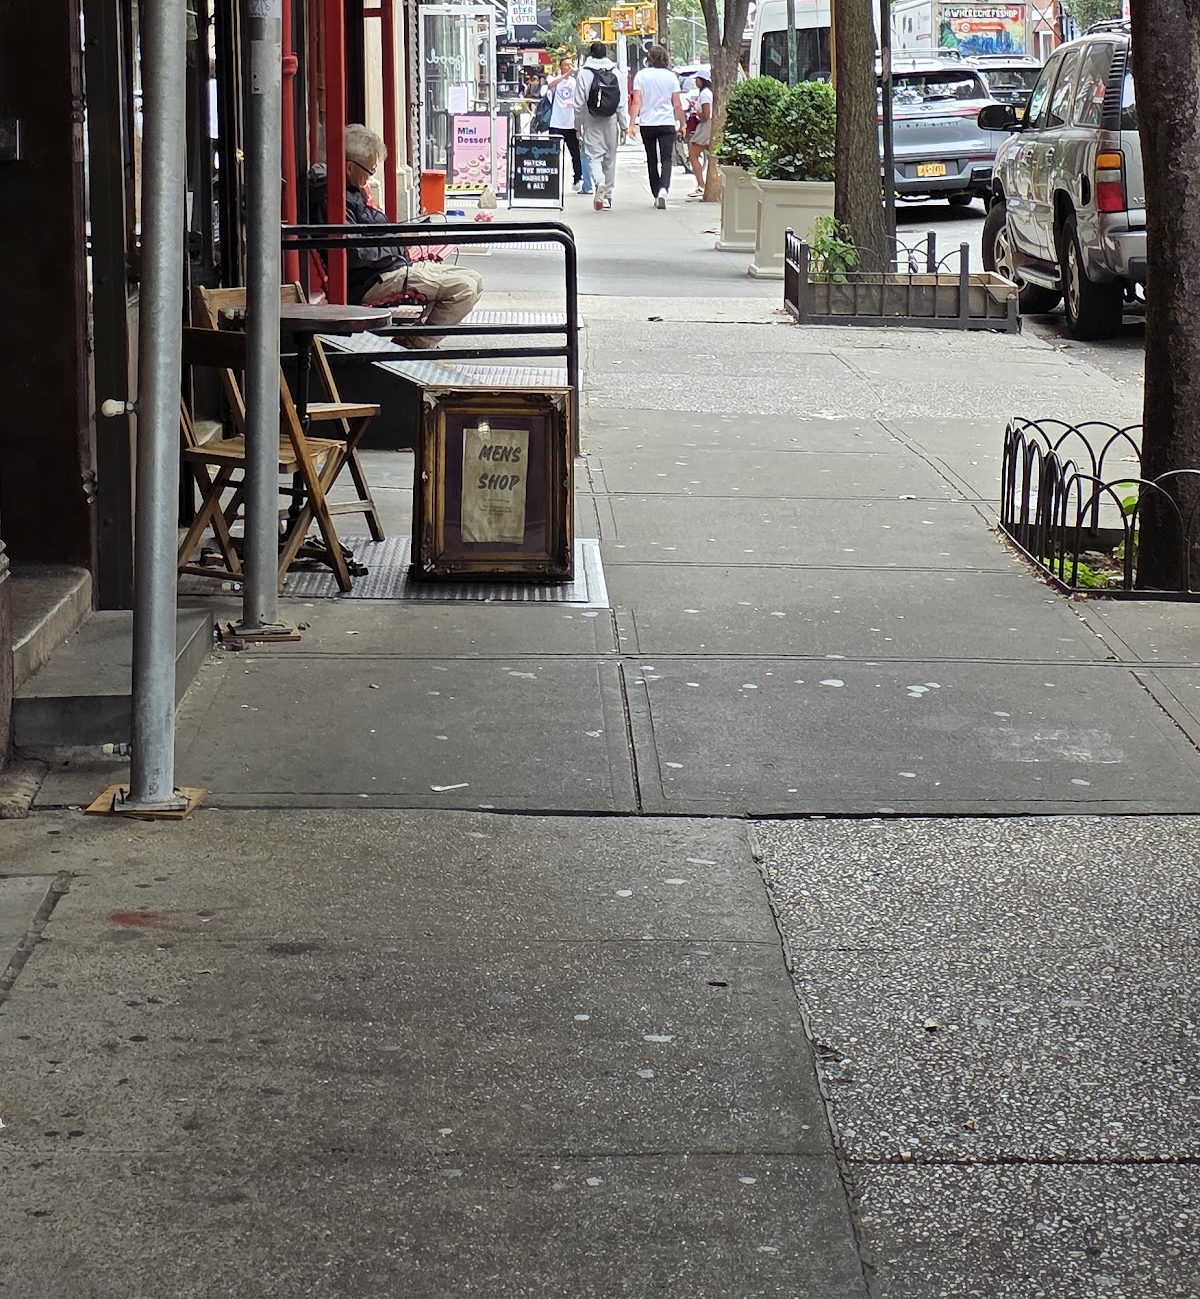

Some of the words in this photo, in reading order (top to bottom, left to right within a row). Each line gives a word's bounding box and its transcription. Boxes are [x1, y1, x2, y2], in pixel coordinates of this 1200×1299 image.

[511, 15, 536, 23] LOTTO
[457, 127, 477, 135] Mini
[531, 142, 559, 159] good
[478, 444, 522, 463] MENS
[477, 473, 521, 492] SHOP
